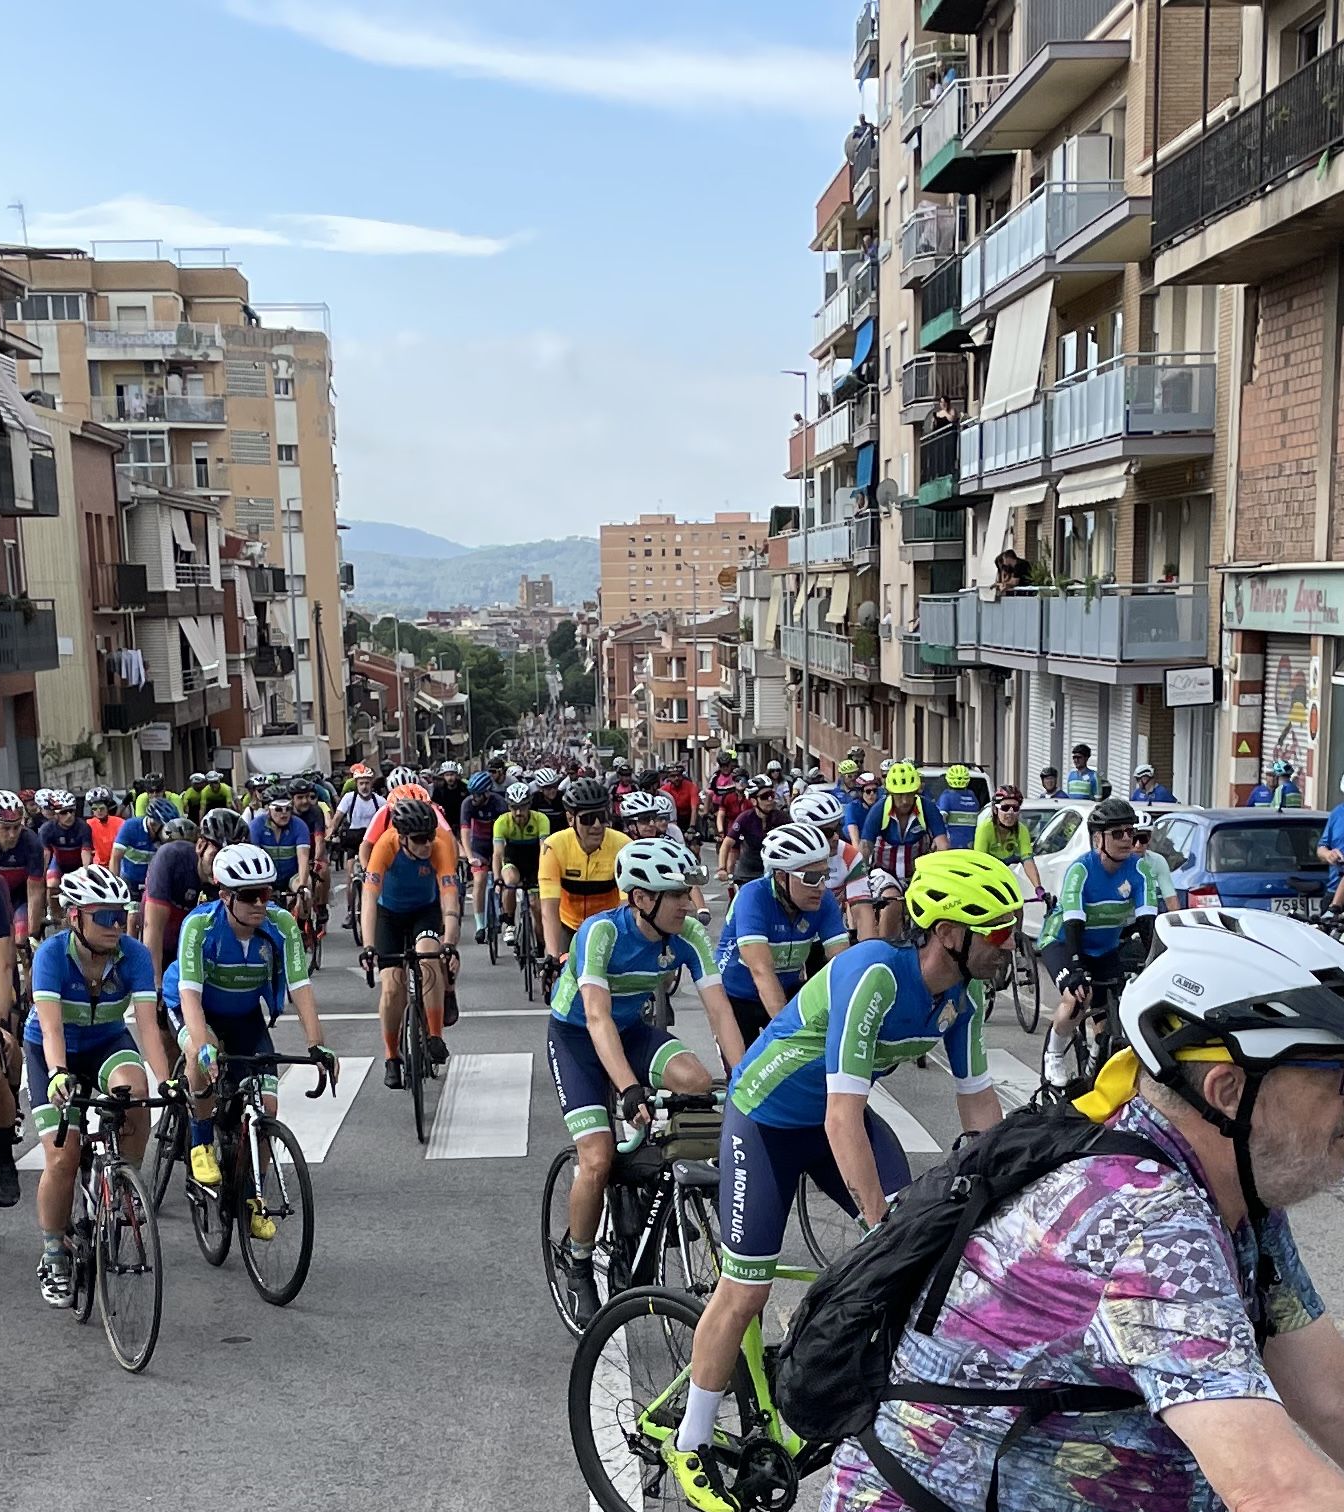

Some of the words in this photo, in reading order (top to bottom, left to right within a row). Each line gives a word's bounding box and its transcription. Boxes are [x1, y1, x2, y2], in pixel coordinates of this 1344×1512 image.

[857, 991, 884, 1037] Grupa
[853, 1042, 869, 1060] La
[731, 1135, 746, 1165] A.C.
[646, 1172, 672, 1225] CANYN
